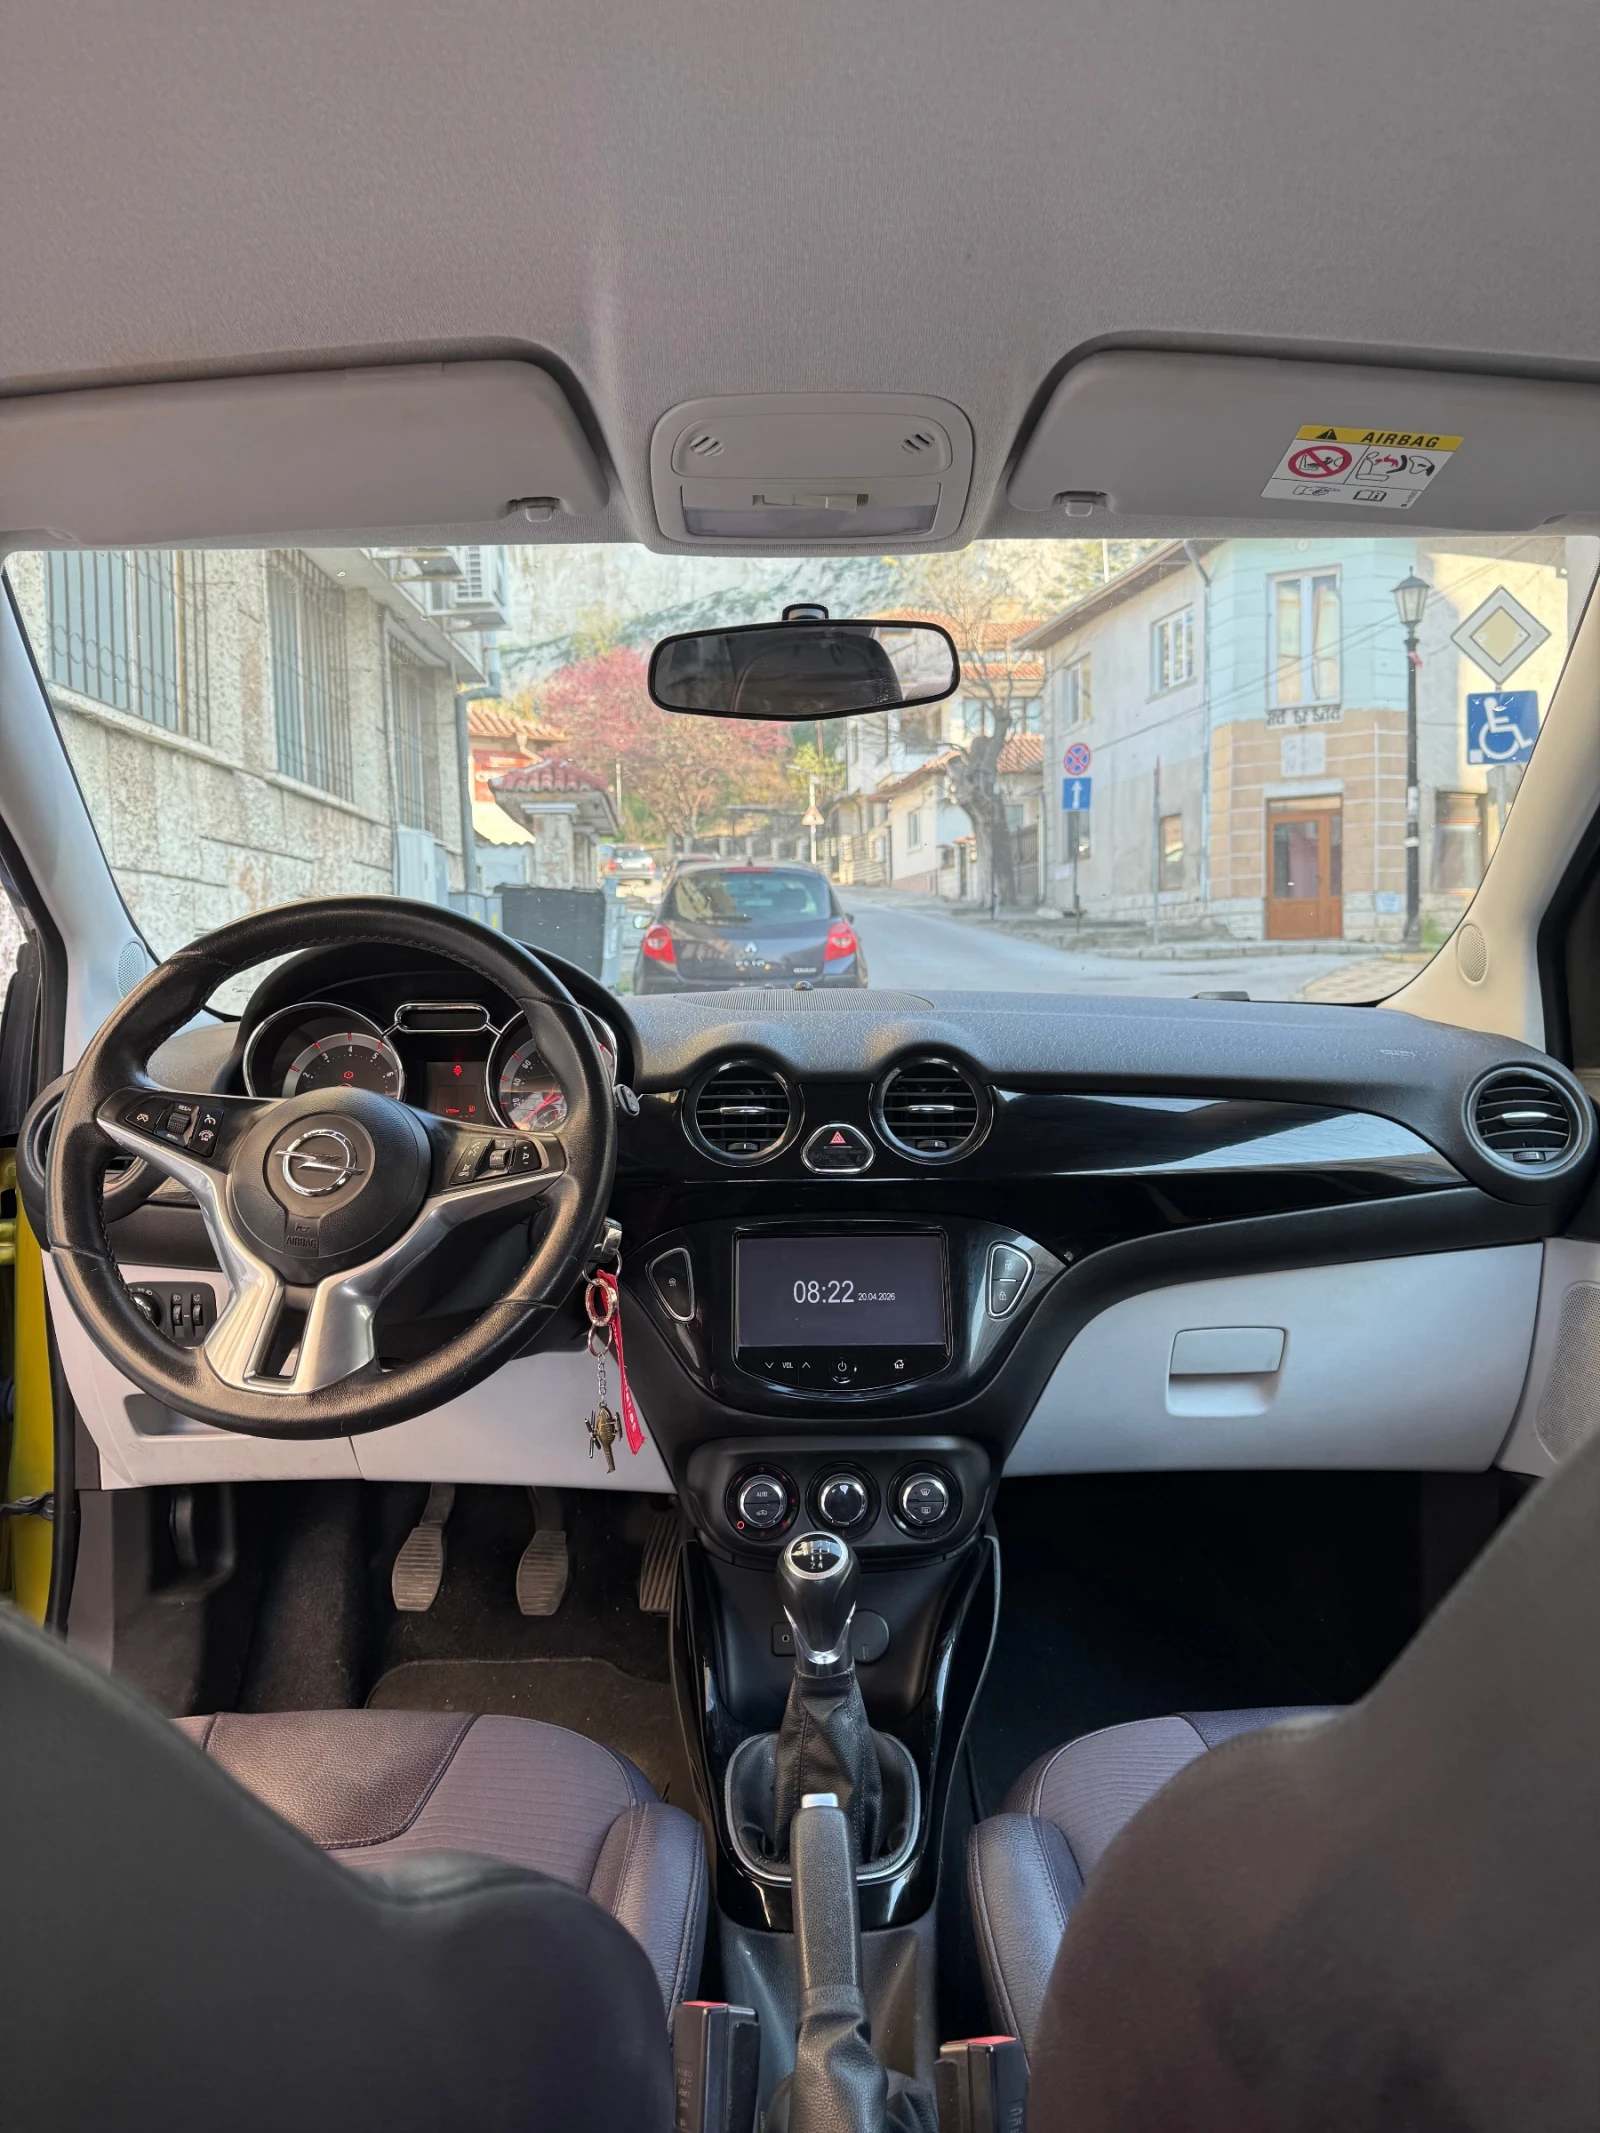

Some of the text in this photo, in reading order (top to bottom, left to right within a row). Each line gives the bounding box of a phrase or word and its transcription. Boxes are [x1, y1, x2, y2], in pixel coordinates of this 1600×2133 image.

[1360, 432, 1440, 448] AIRBAG
[347, 1045, 353, 1053] 4
[321, 1052, 329, 1060] 3
[371, 1052, 379, 1060] 5
[302, 1071, 311, 1079] 2
[285, 1235, 317, 1249] AIRBAG
[793, 1280, 896, 1304] 08:22 20.04.2026
[810, 1561, 823, 1570] 2 4
